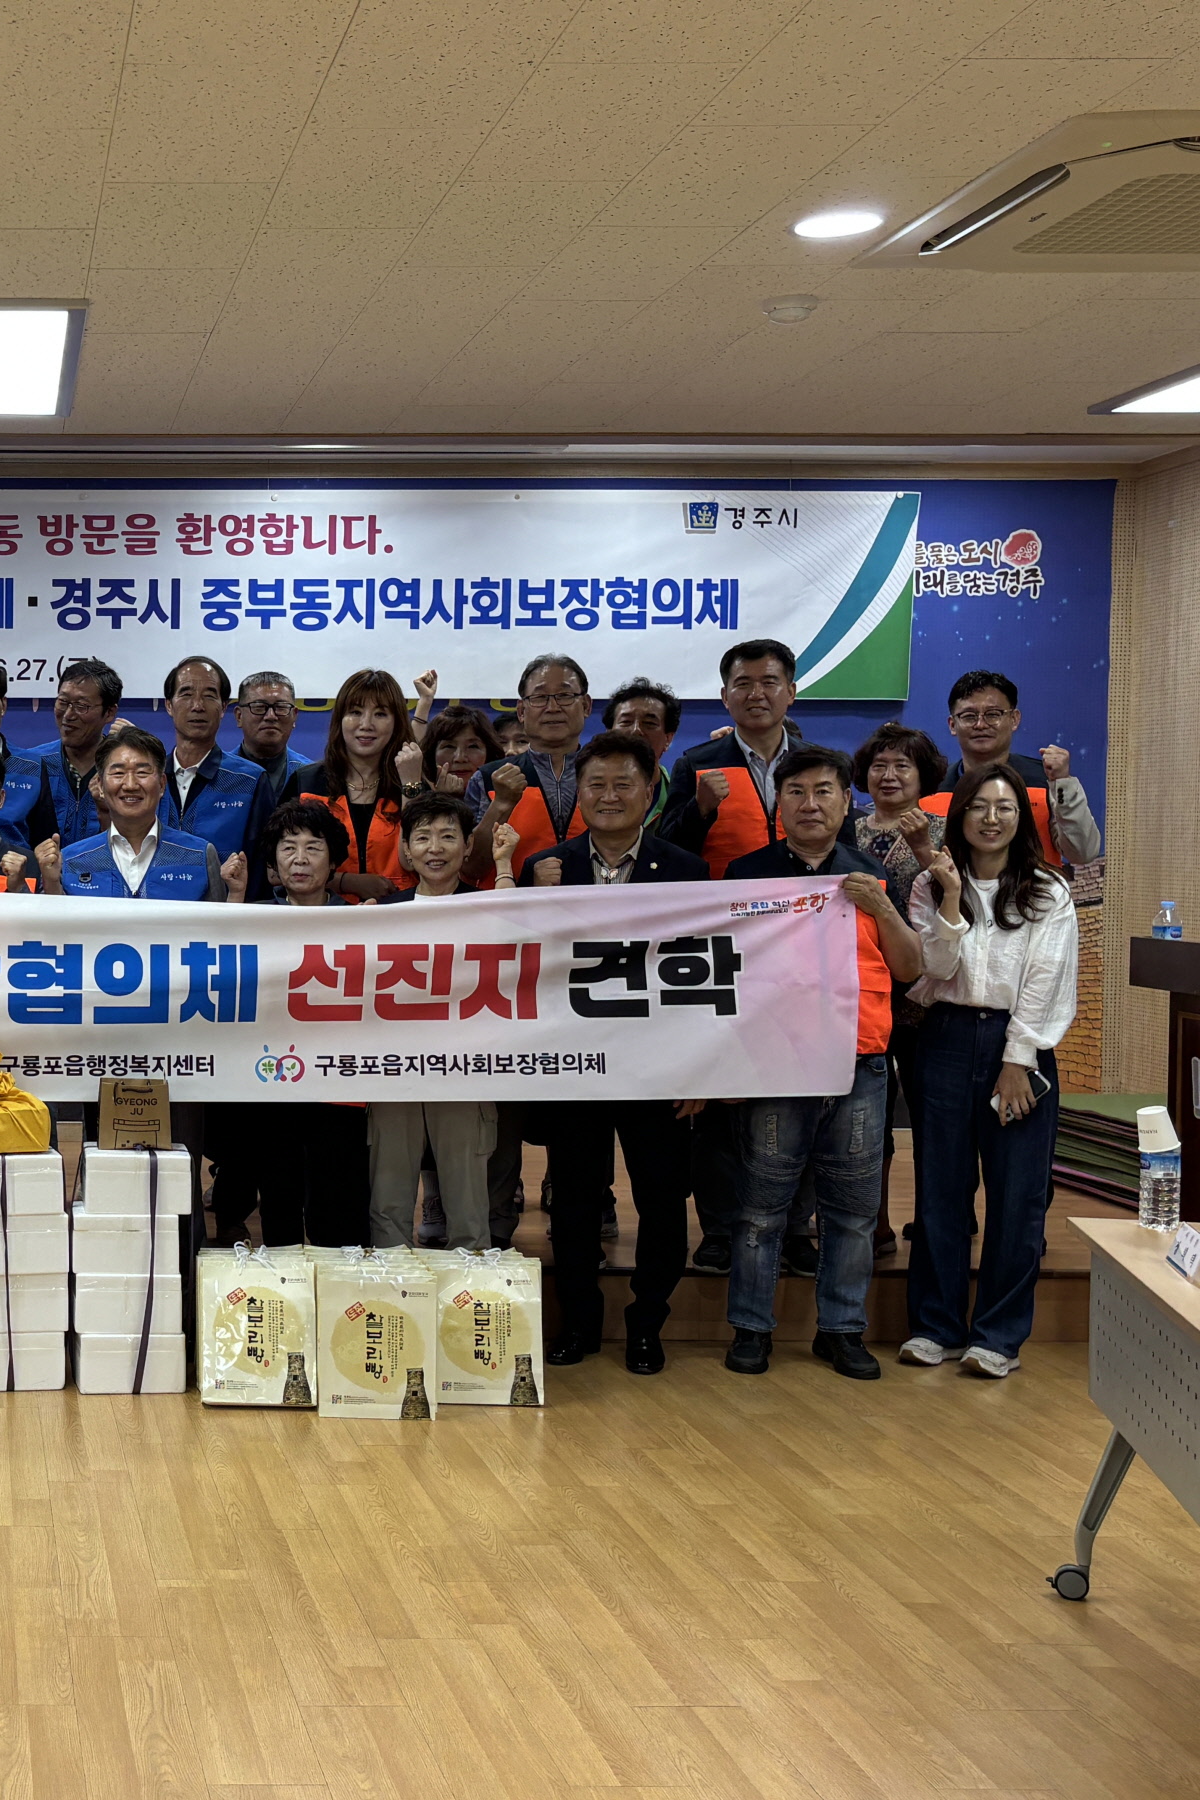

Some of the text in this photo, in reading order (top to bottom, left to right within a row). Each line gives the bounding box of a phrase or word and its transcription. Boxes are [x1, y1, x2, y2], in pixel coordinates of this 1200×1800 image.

[724, 507, 798, 529] 경주시
[37, 514, 160, 556] 방문을
[176, 513, 393, 556] 환영합니다.
[961, 540, 1000, 566] 도시
[996, 568, 1042, 597] 경주
[200, 577, 739, 632] 중부동지역사회보장협의체
[793, 893, 829, 913] 포항
[287, 942, 542, 1022] 선진지
[568, 935, 742, 1018] 견학
[0, 1055, 215, 1077] 구룡포읍행정복지센터
[315, 1052, 606, 1077] 구룡포읍지역사회보장협의체
[116, 1098, 158, 1106] GYEONG
[130, 1108, 144, 1116] JU
[247, 1296, 265, 1363] 찰보리빵
[473, 1299, 492, 1365] 찰보리빵
[365, 1311, 384, 1379] 찰보리빵
